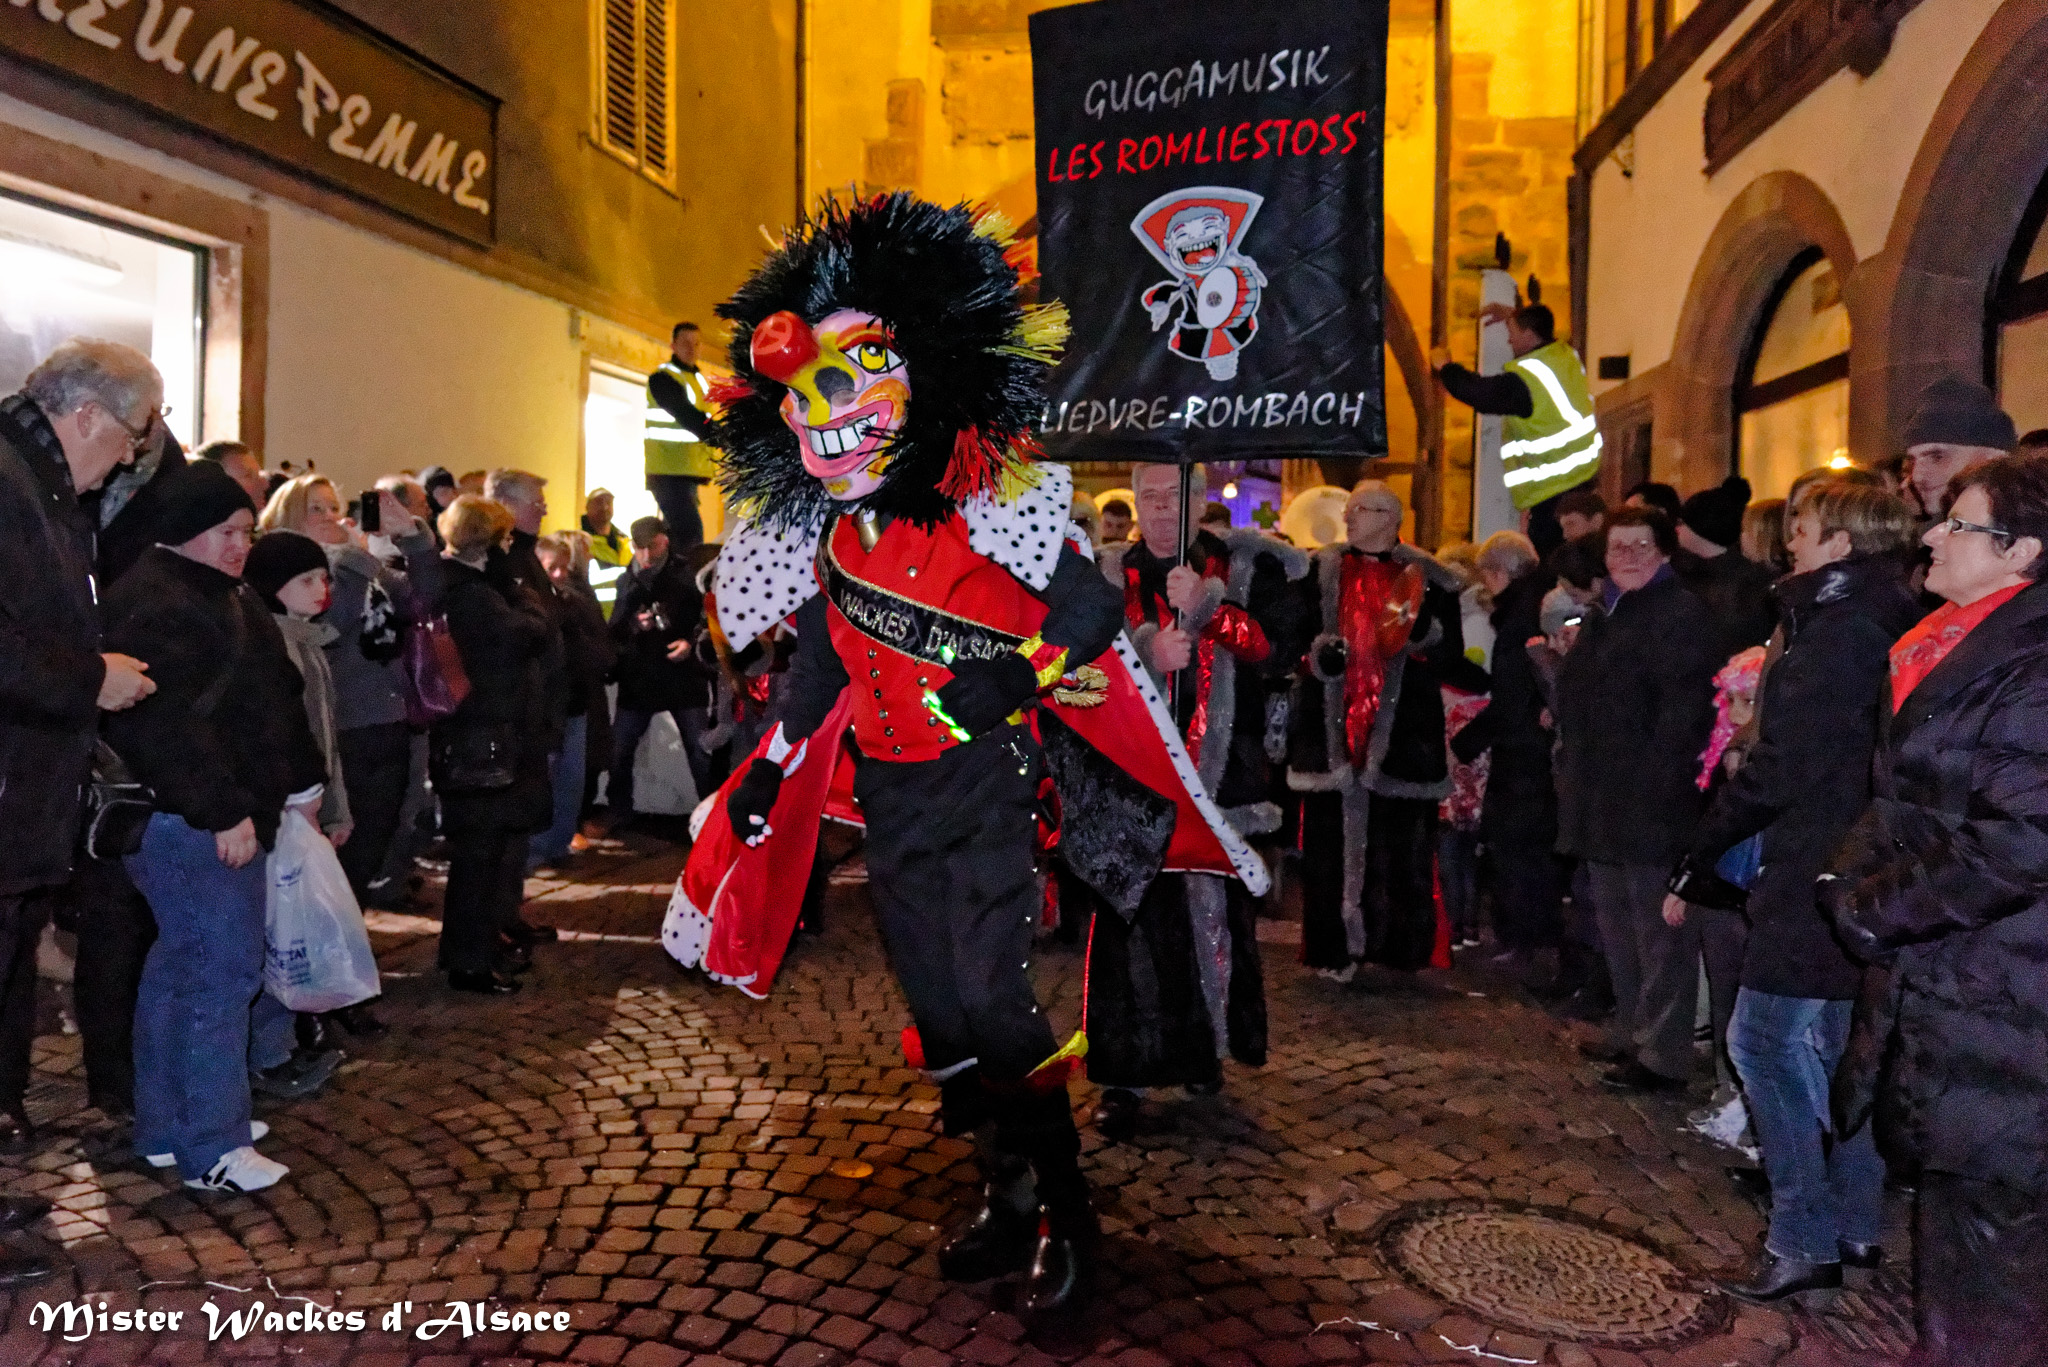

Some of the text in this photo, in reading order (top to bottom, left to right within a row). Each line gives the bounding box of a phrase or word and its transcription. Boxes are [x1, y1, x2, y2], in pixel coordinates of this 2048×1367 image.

[8, 0, 490, 215] EUNE FEMME
[1084, 45, 1331, 120] GUGGAMUSIK
[1048, 141, 1105, 184] LES
[839, 588, 911, 641] WACKES
